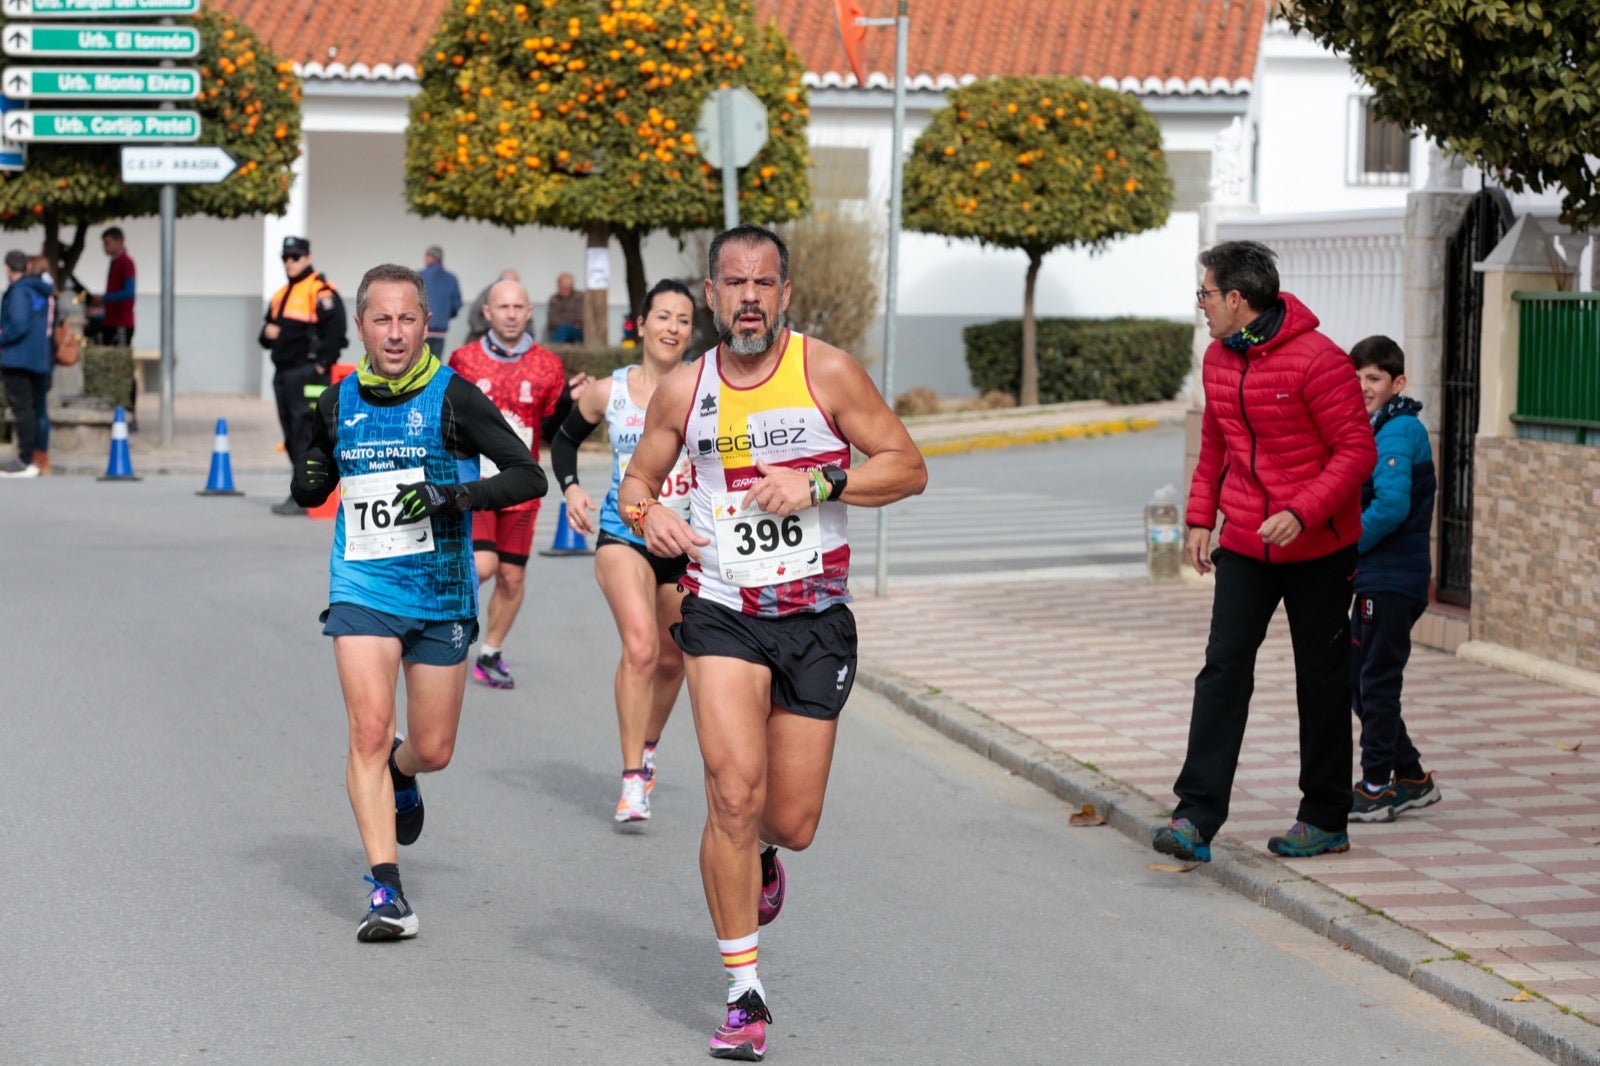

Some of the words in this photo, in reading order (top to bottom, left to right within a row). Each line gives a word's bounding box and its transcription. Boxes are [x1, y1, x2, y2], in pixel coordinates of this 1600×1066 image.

[78, 31, 112, 49] Urb.
[115, 32, 132, 49] El
[58, 74, 91, 91] Urb.
[94, 75, 145, 92] Monte
[147, 75, 191, 92] Elvira
[54, 117, 88, 134] Urb.
[91, 117, 143, 137] Cortijo
[341, 448, 375, 461] PAZITO
[377, 450, 385, 458] a
[386, 446, 427, 458] PAZITO
[369, 460, 396, 470] Motril
[734, 514, 804, 556] 396
